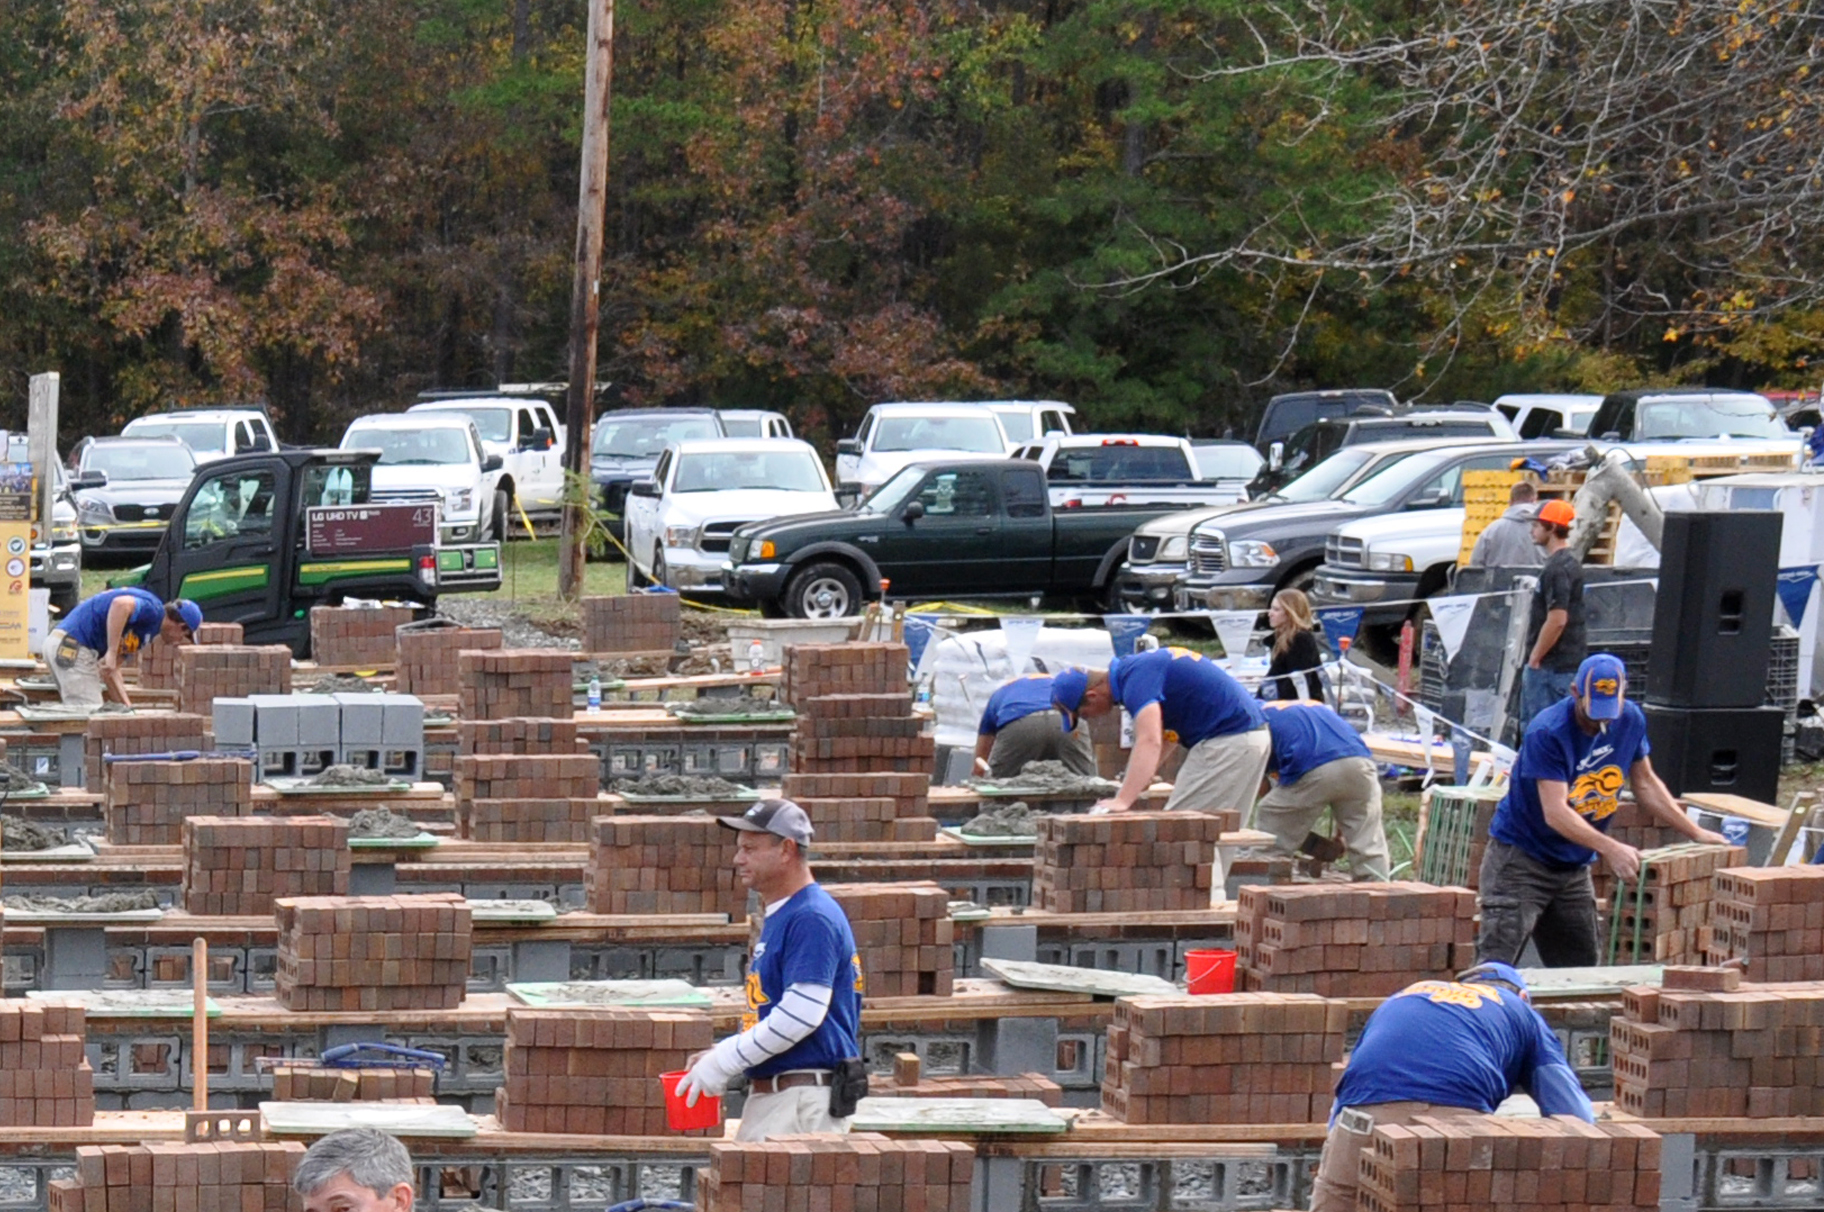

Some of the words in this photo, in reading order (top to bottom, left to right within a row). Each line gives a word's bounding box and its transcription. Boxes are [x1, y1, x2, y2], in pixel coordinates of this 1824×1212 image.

[312, 512, 324, 522] LG
[326, 511, 345, 521] UHD
[346, 510, 359, 520] TV
[412, 508, 433, 524] 43
